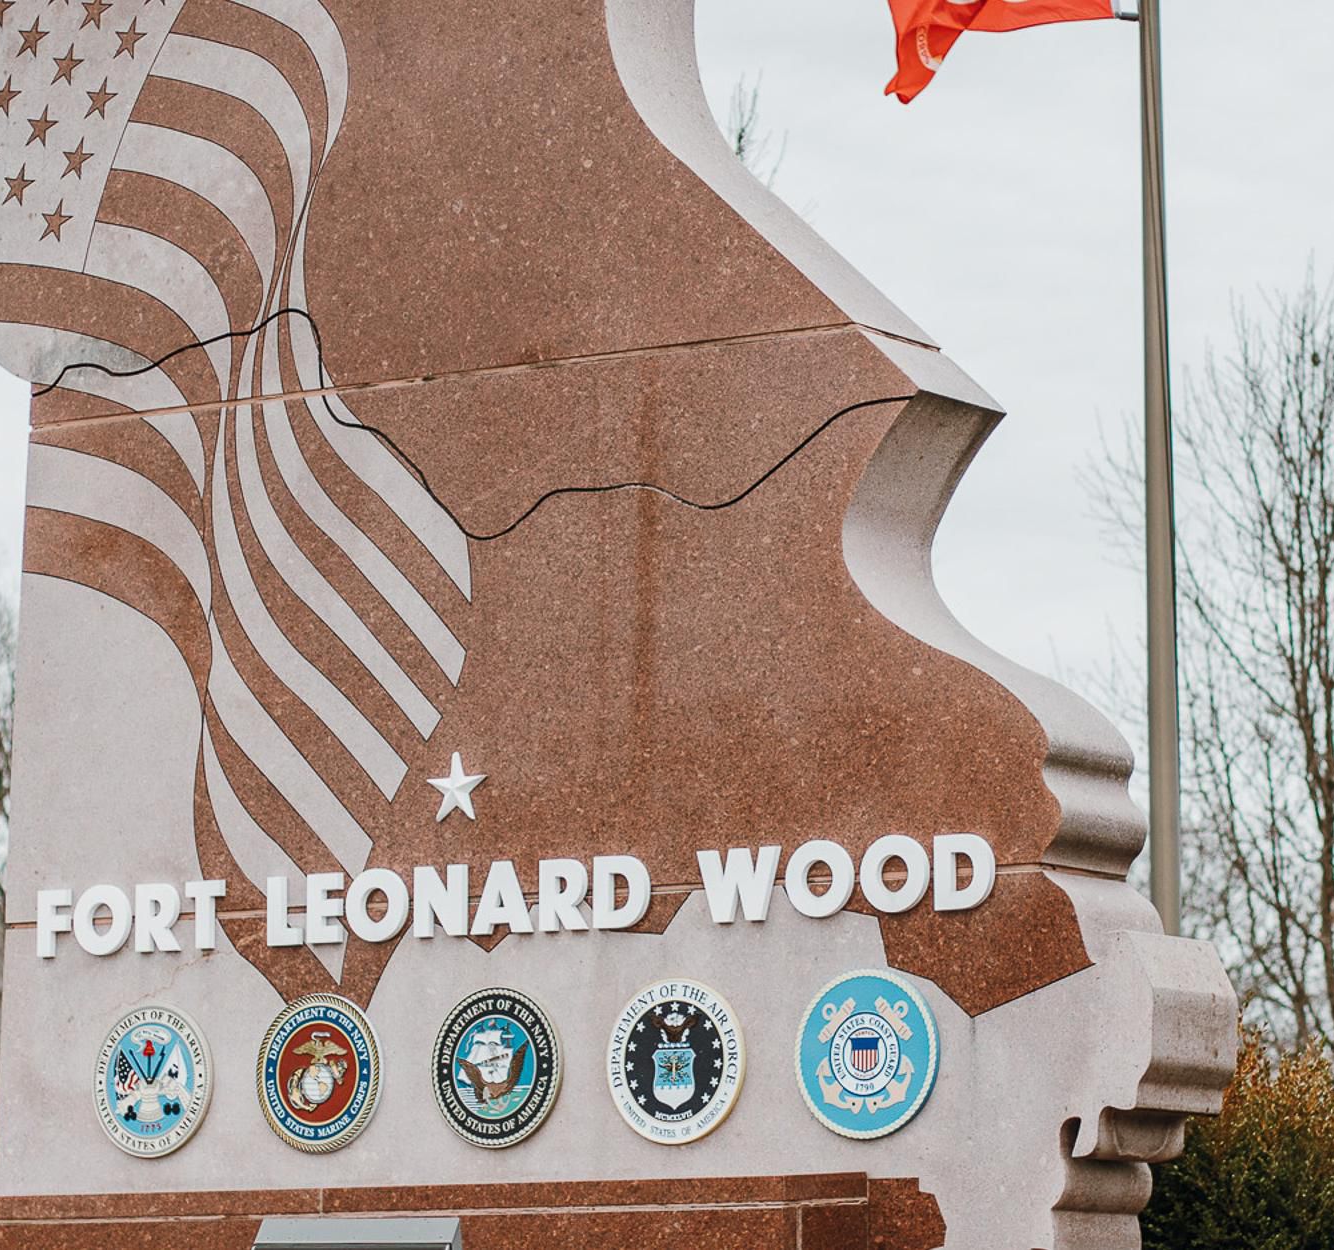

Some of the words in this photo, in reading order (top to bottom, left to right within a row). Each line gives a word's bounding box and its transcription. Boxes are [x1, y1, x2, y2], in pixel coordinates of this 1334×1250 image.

[36, 879, 226, 958] FORT
[266, 855, 651, 947] LEONARD
[696, 833, 995, 923] WOOD
[99, 1012, 147, 1074] DEPARTMENT
[150, 1011, 164, 1020] OF
[168, 1014, 185, 1032] THE
[186, 1033, 203, 1065] ARMY
[269, 1007, 326, 1061] DEPARTMENT
[327, 1009, 337, 1020] OF
[338, 1013, 354, 1031] THE
[351, 1029, 369, 1061] NAVY
[441, 999, 494, 1064] DEPARTMENT
[496, 999, 512, 1011] OF
[513, 1004, 533, 1027] THE
[532, 1025, 549, 1058] NAVY
[611, 990, 655, 1088] DEPARTMENT
[659, 984, 678, 997] OF
[682, 985, 708, 1006] THE
[707, 1002, 728, 1025] AIR
[724, 1028, 738, 1085] FORCE
[838, 1016, 866, 1040] STATES
[869, 1017, 893, 1041] COAST
[834, 1043, 847, 1080] UNITED
[884, 1042, 897, 1078] GUARD
[97, 1088, 118, 1133] UNITED
[120, 1133, 155, 1150] STATES
[159, 1136, 171, 1147] OF
[175, 1084, 204, 1137] AMERICA
[267, 1080, 285, 1118] UNITED
[285, 1118, 315, 1137] STATES
[317, 1115, 350, 1137] MARINE
[351, 1080, 368, 1115] CORPS
[441, 1081, 467, 1121] UNITED
[466, 1117, 501, 1134] STATES
[502, 1118, 517, 1132] OF
[518, 1076, 548, 1125] AMERICA
[623, 1101, 646, 1127] UNITED
[650, 1126, 676, 1138] STATES
[681, 1126, 692, 1136] OF
[696, 1100, 726, 1129] AMERICA
